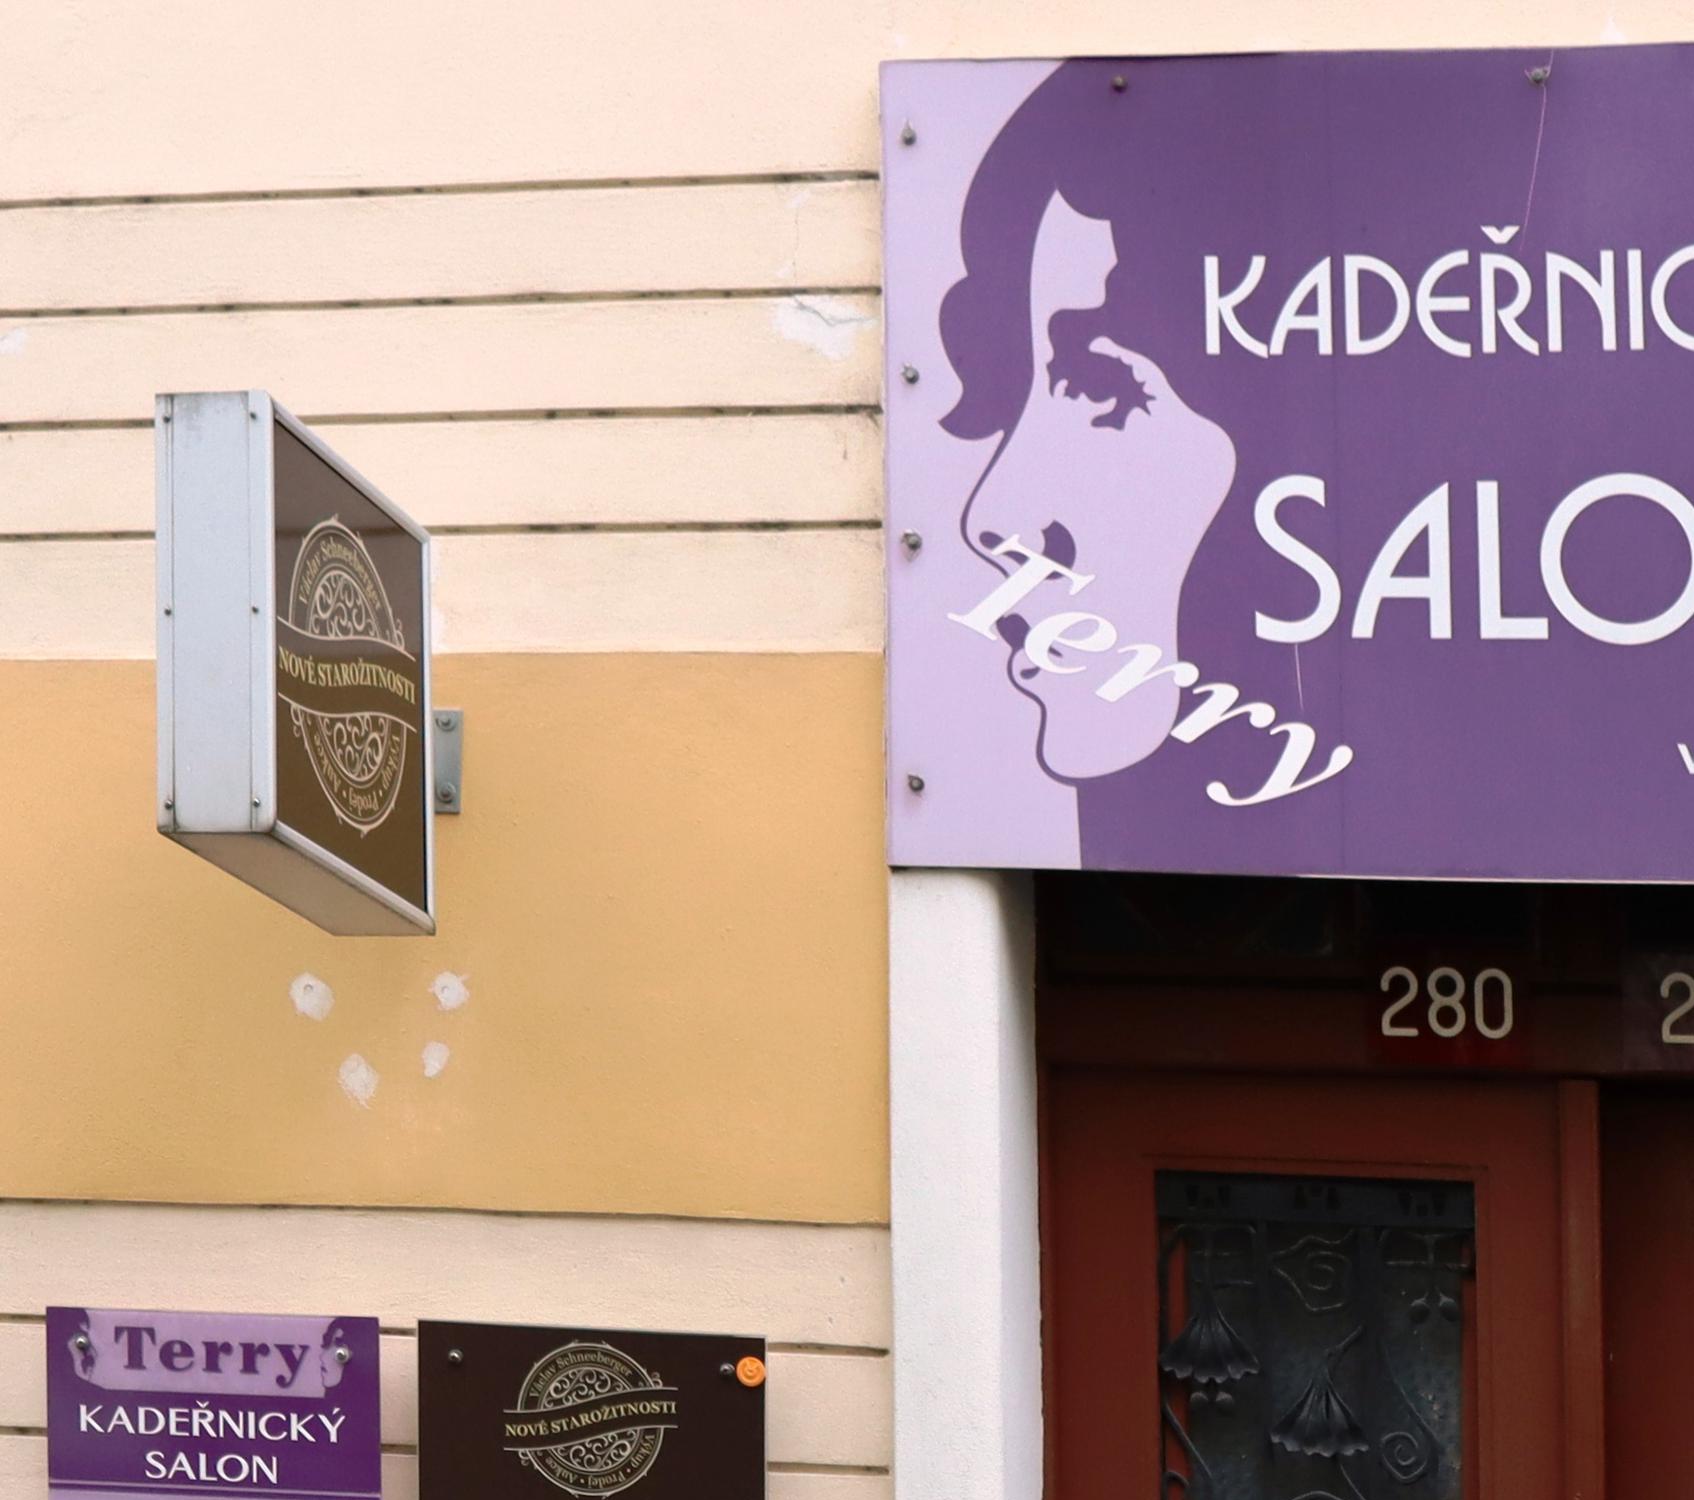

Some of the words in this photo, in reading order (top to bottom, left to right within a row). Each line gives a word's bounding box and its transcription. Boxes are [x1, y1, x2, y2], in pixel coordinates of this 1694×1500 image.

[278, 644, 317, 685] NOVÉ
[317, 657, 416, 705] STAROŽITNOSTI
[947, 533, 1353, 806] Terry
[1380, 966, 1513, 1039] 280
[114, 1326, 311, 1388] Terry
[529, 1363, 555, 1399] Václav
[556, 1351, 633, 1378] Schneeberger
[79, 1400, 346, 1443] KADEŘNICKÝ
[505, 1420, 550, 1437] NOVÉ
[550, 1401, 678, 1436] STAROŽITNOSTI
[144, 1451, 279, 1484] SALON
[587, 1470, 627, 1489] Prodej
